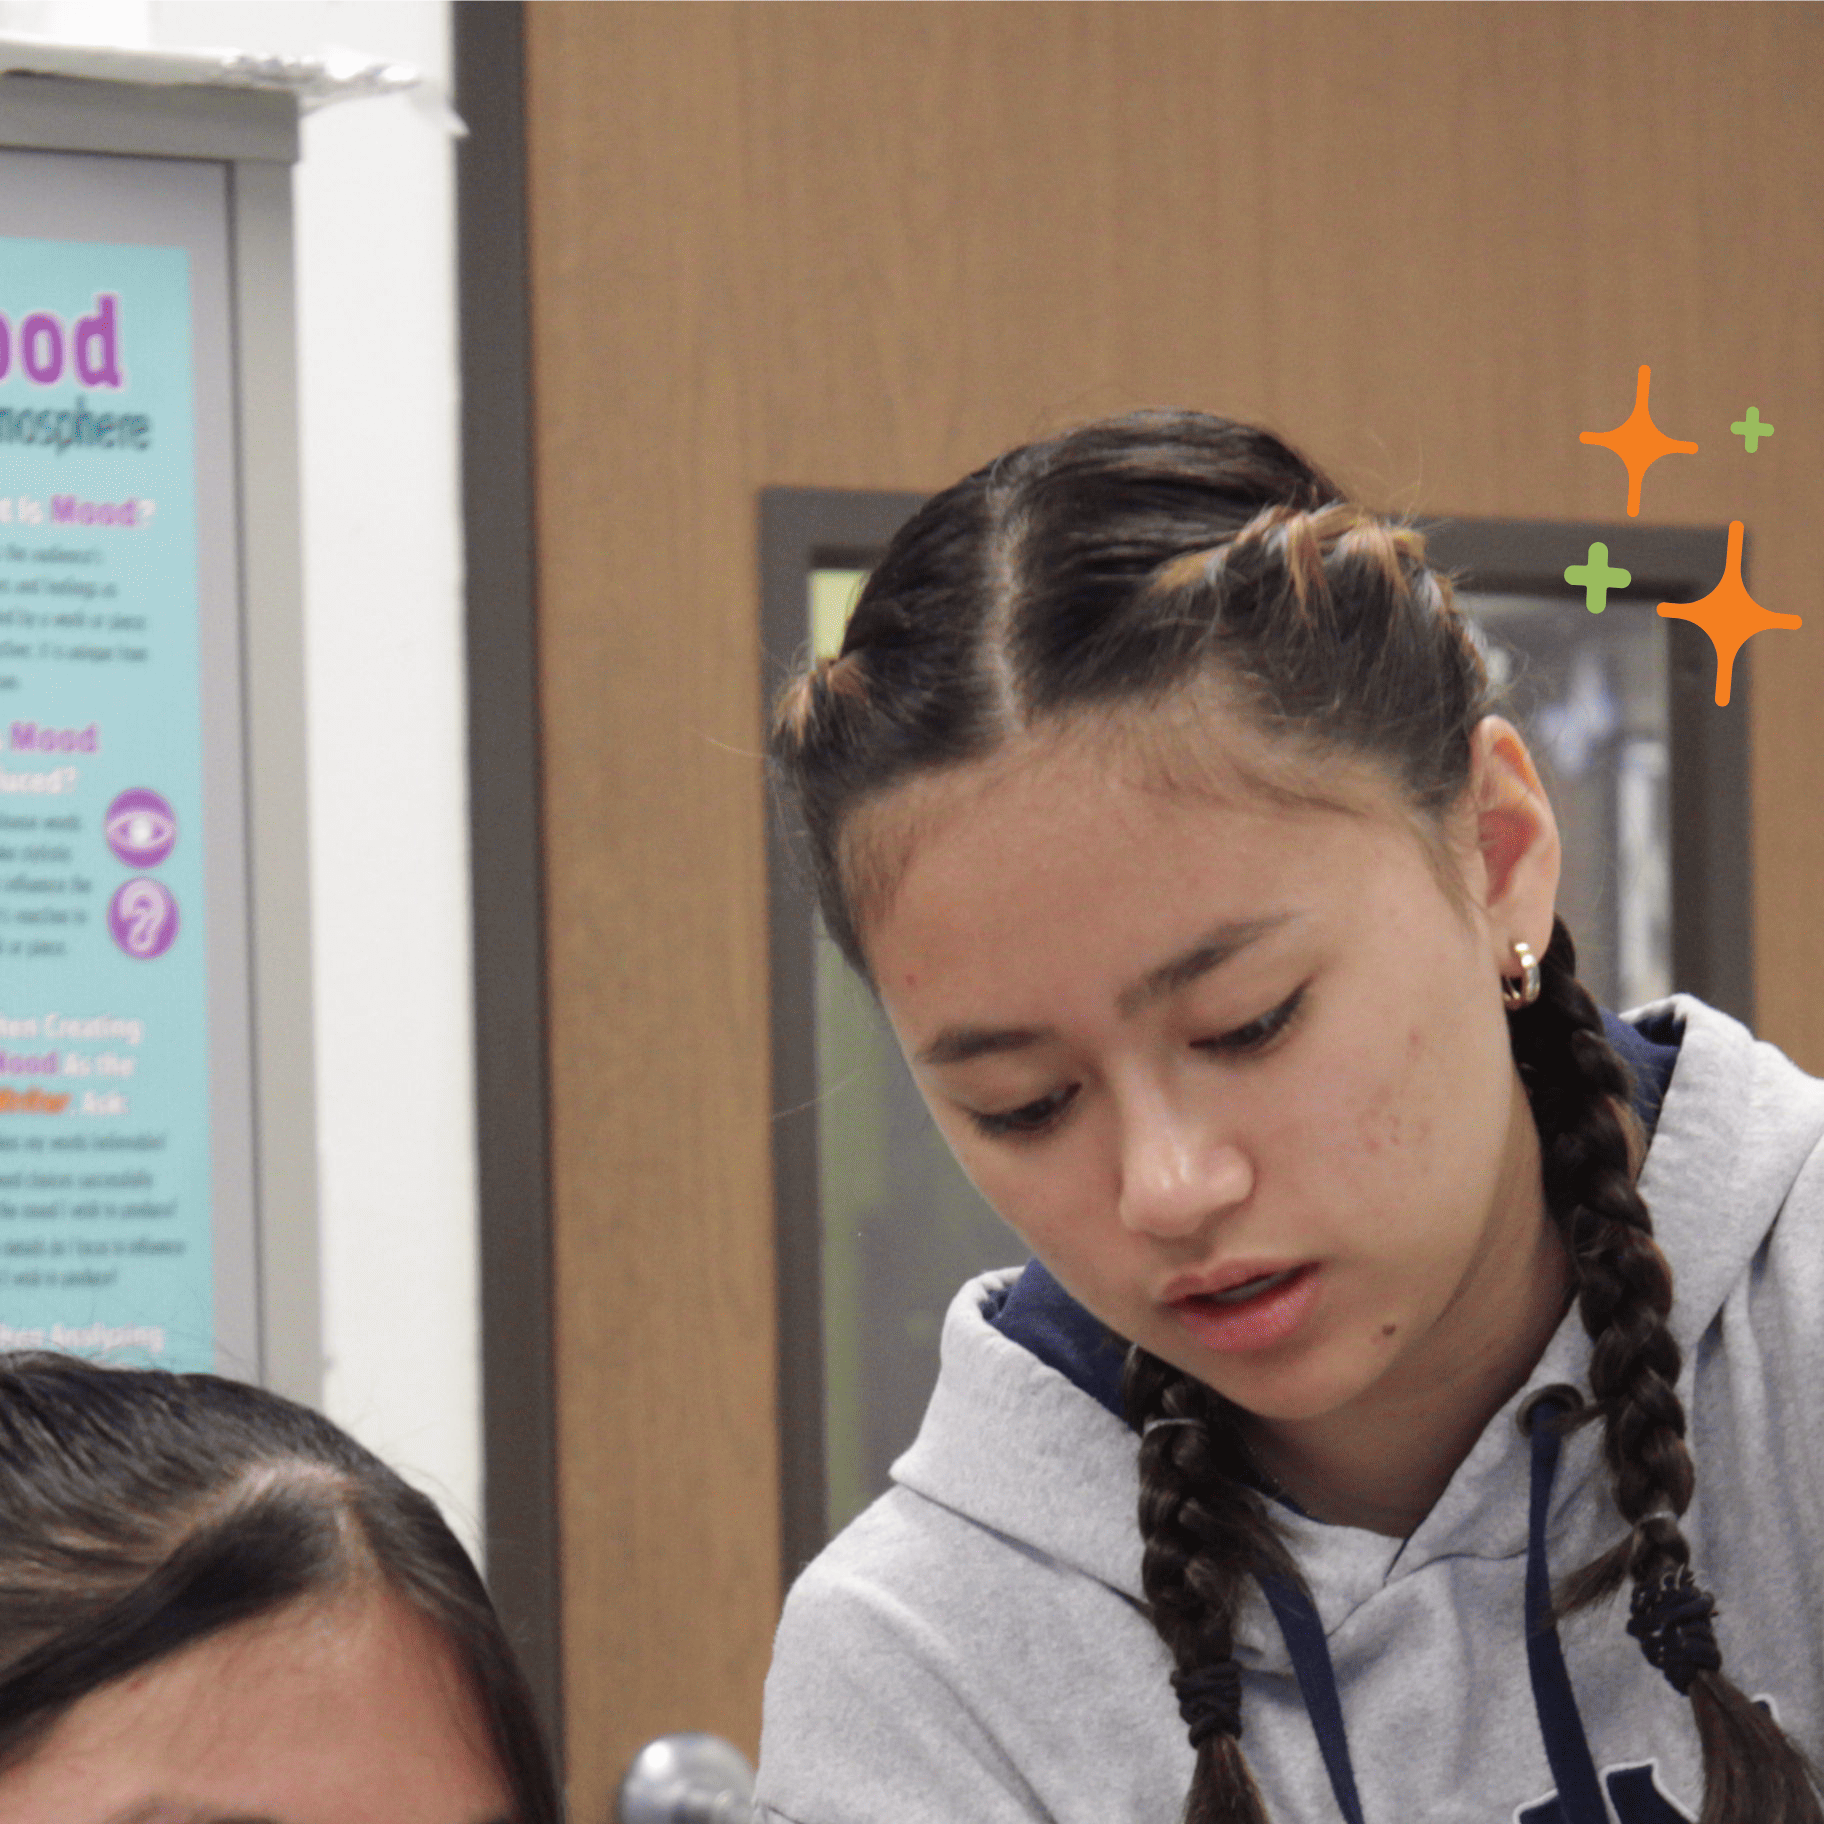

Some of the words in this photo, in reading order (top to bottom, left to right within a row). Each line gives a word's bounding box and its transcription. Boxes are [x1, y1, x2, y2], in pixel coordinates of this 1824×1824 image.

[18, 494, 43, 525] Is
[50, 493, 156, 529] Mood?
[9, 720, 99, 753] Mood
[43, 1013, 143, 1045] Creating
[64, 1052, 91, 1076] As
[96, 1054, 135, 1076] the
